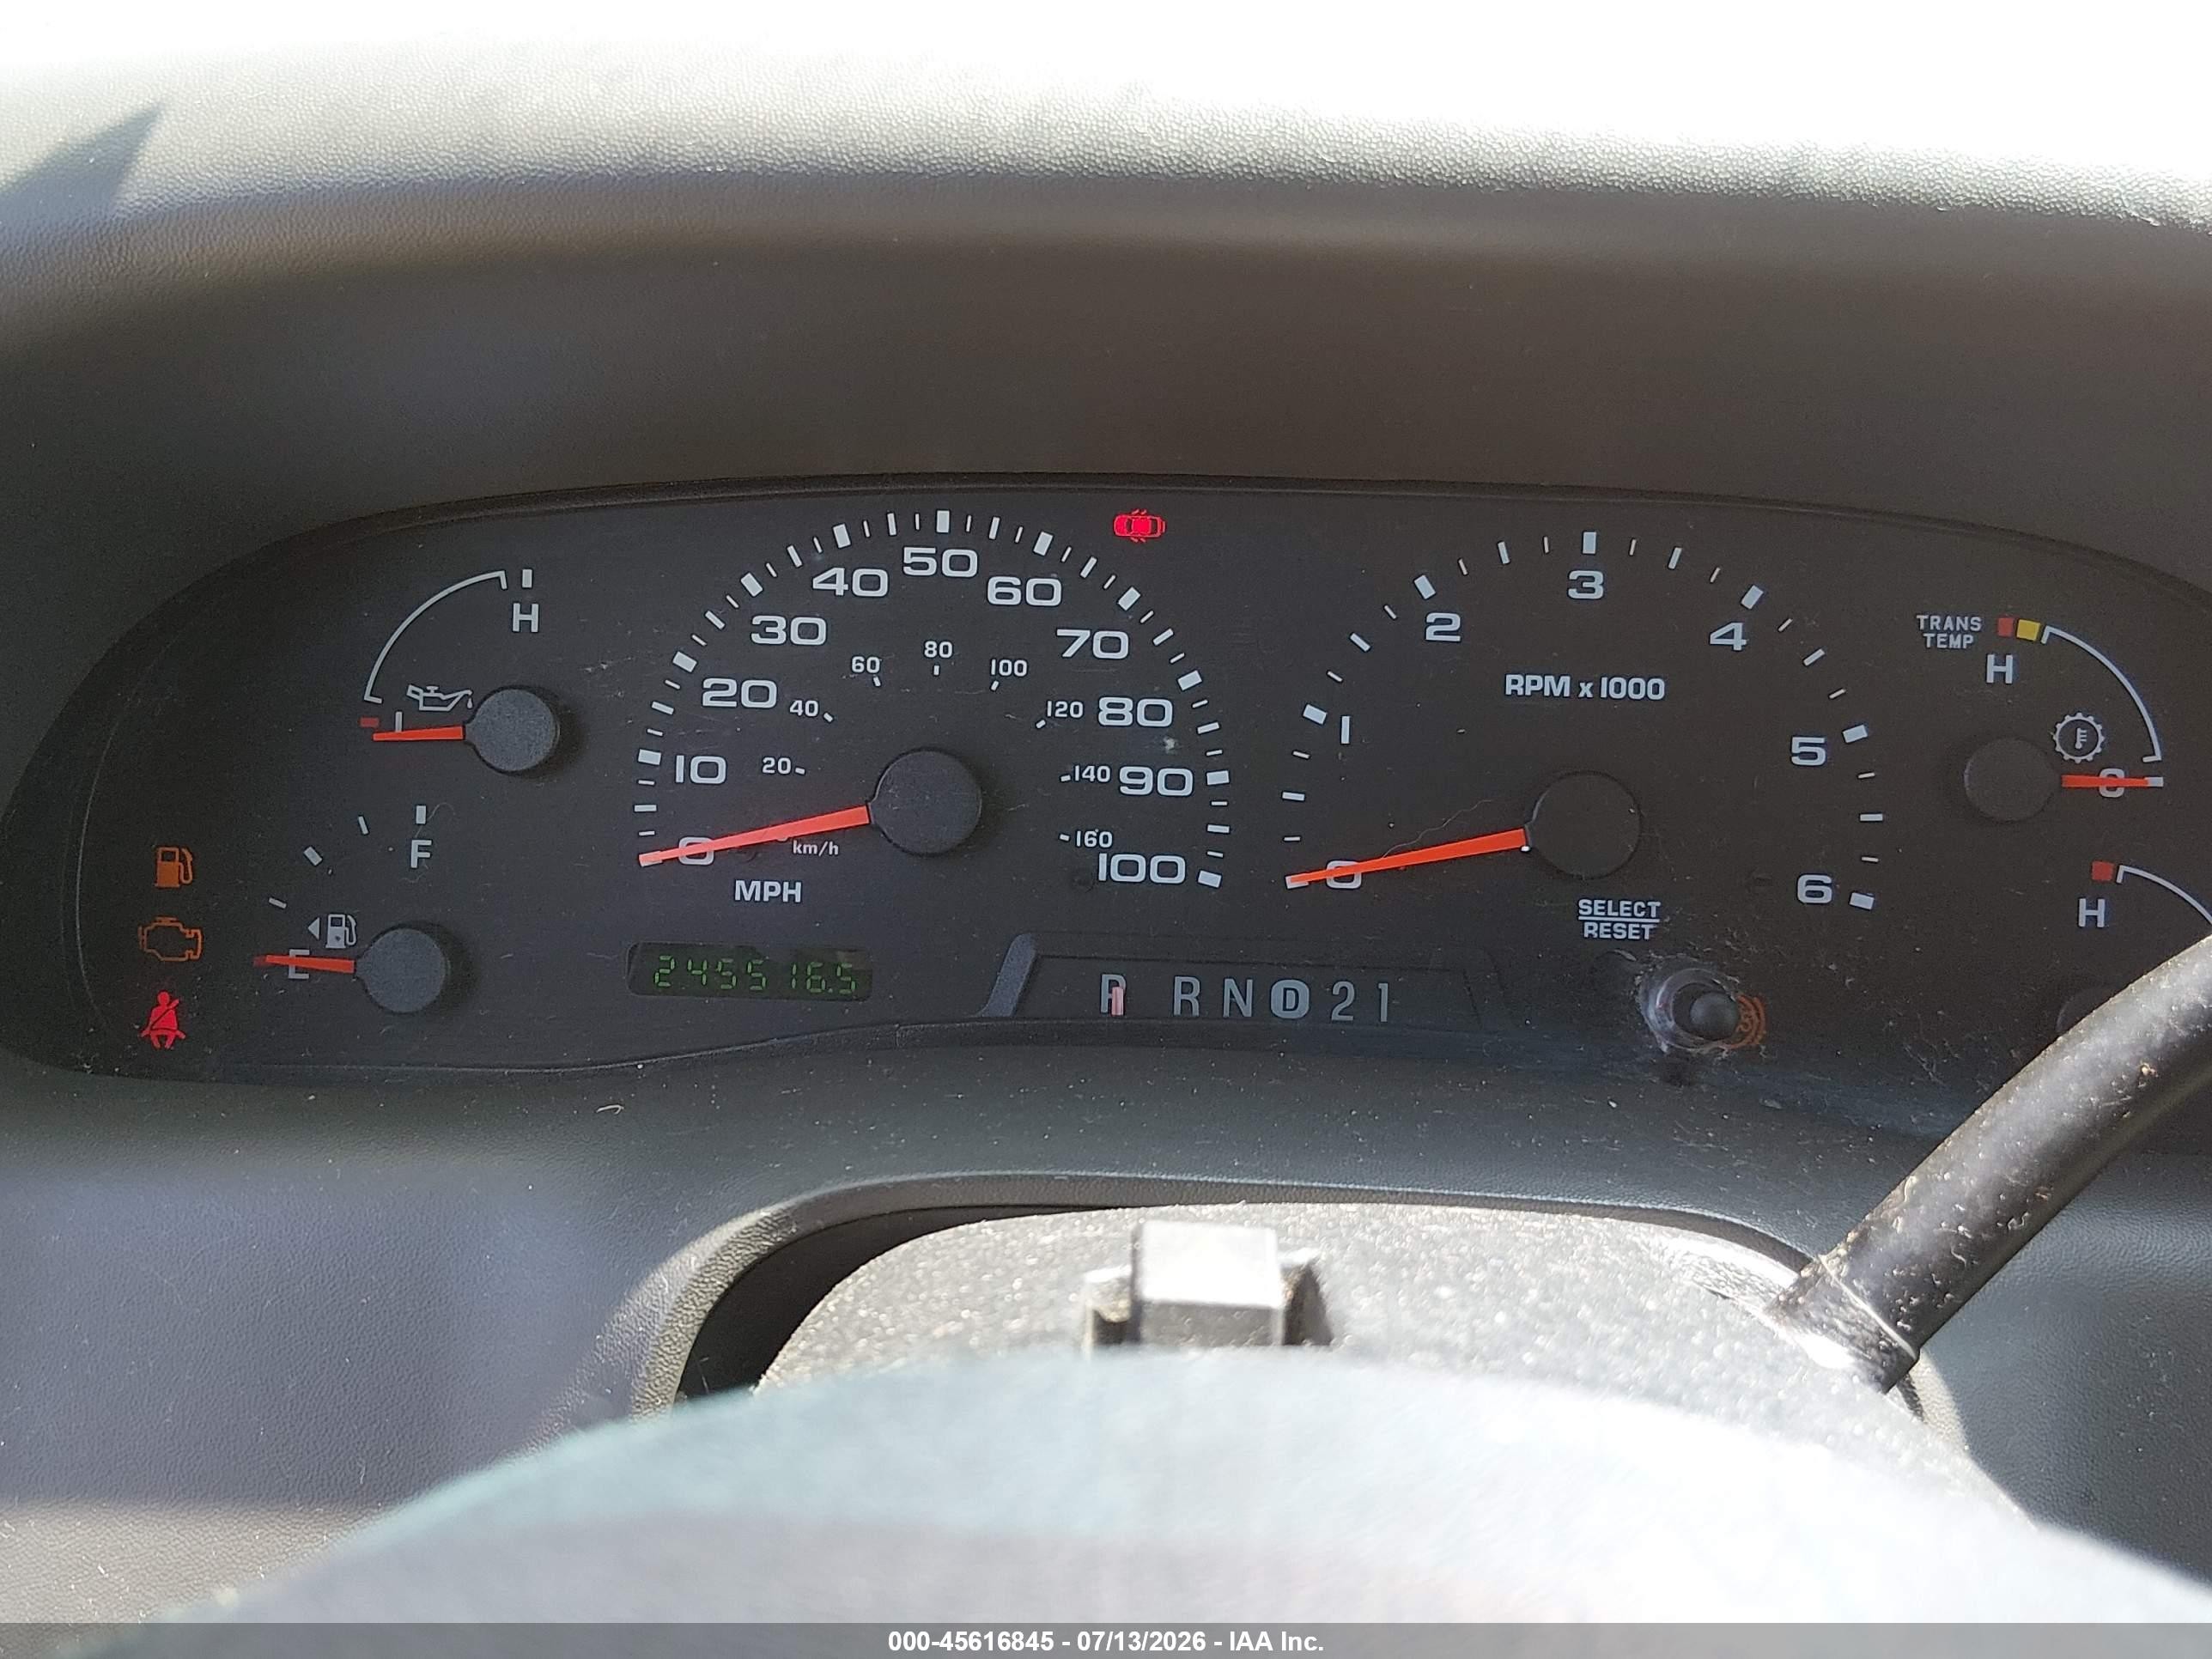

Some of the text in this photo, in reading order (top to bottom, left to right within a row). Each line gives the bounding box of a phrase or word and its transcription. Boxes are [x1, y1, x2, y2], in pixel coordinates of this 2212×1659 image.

[902, 547, 979, 578] 50
[812, 568, 890, 597] 40
[987, 578, 1062, 606] 60
[1568, 570, 1605, 599] 3
[513, 603, 539, 632] H
[751, 616, 827, 646] 30
[1425, 612, 1462, 642] 2
[1917, 615, 1983, 631] TRANS
[925, 641, 953, 659] 80
[1056, 629, 1129, 659] 70
[1710, 623, 1747, 651] 4
[1923, 633, 1974, 649] TEMP
[851, 657, 880, 674] 60
[990, 659, 1028, 678] 100
[1986, 654, 2014, 684] H
[702, 678, 778, 708] 20
[1505, 675, 1666, 700] RPM x 1000
[789, 700, 819, 717] 40
[1046, 701, 1084, 719] 120
[1097, 697, 1174, 727] 80
[1341, 715, 1351, 744] 1
[1790, 736, 1826, 766] 5
[675, 755, 726, 785] 10
[762, 757, 792, 775] 20
[1073, 765, 1111, 783] 140
[1118, 767, 1194, 797] 90
[410, 839, 432, 868] F
[678, 836, 714, 866] 0
[793, 841, 839, 856] km/h
[1075, 830, 1113, 848] 160
[1098, 853, 1186, 884] 100
[1326, 860, 1362, 889] 0
[734, 880, 802, 902] MPH
[1796, 874, 1832, 904] 6
[1578, 899, 1661, 918] SELECT
[2079, 898, 2106, 927] H
[1584, 921, 1654, 940] RESET
[1173, 975, 1200, 1016] R
[1223, 978, 1254, 1018] N
[1271, 979, 1310, 1019] D
[1331, 981, 1356, 1021] 2
[1378, 982, 1389, 1023] 1
